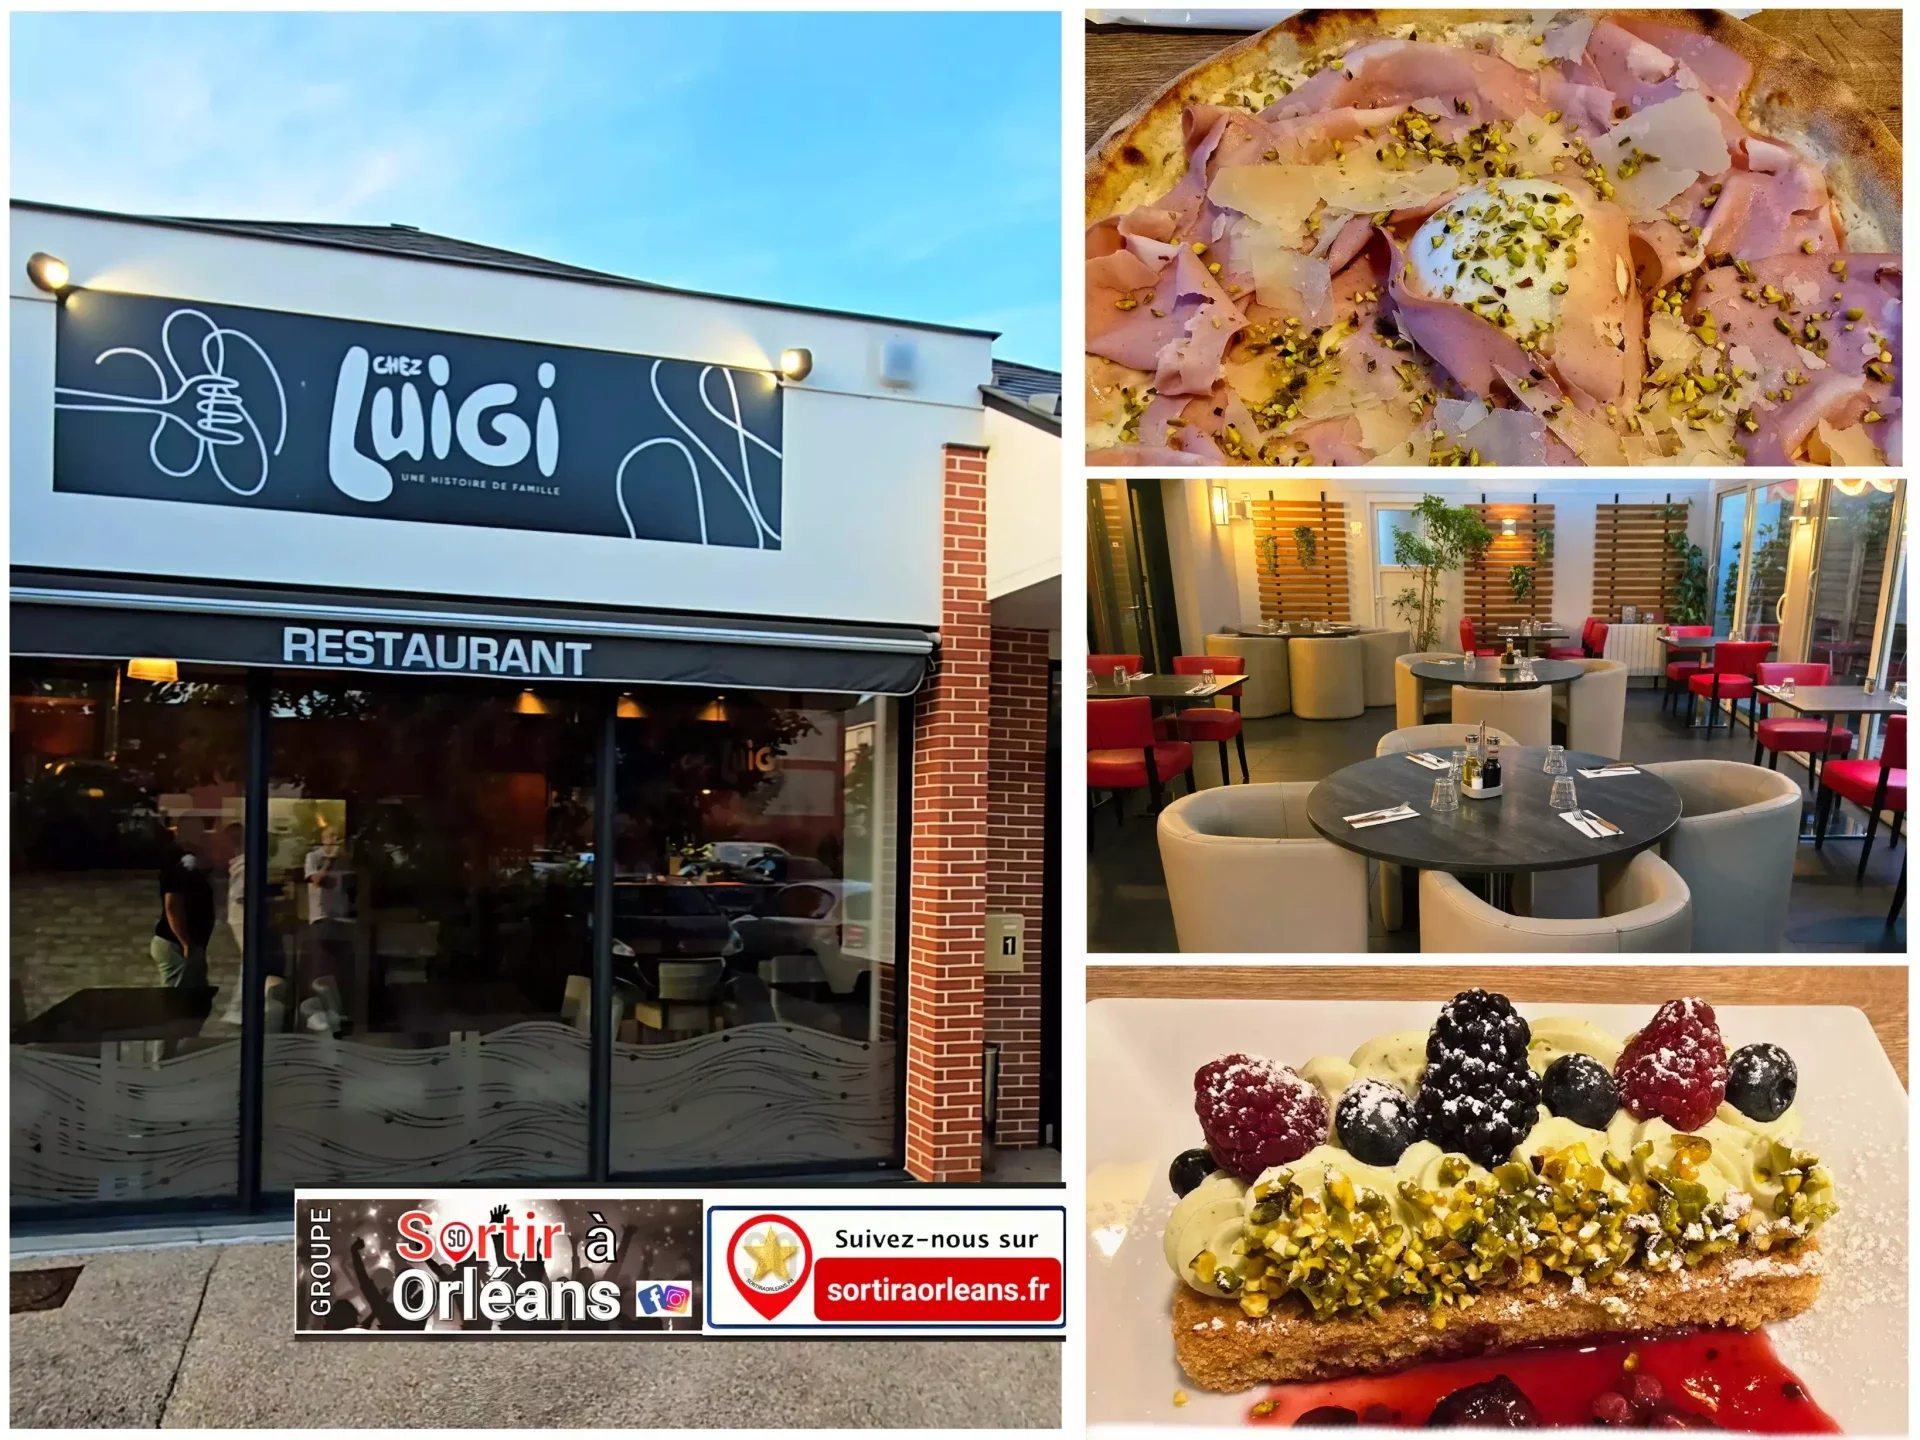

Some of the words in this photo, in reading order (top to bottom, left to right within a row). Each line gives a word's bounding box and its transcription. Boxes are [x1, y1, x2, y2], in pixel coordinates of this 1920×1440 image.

[372, 355, 422, 377] CHEZ
[401, 472, 425, 483] UNE
[431, 475, 487, 489] HISTOIRE
[492, 481, 507, 491] DE
[512, 483, 561, 496] FAMILLE
[283, 626, 593, 676] RESTAURANT
[1004, 937, 1013, 955] 1
